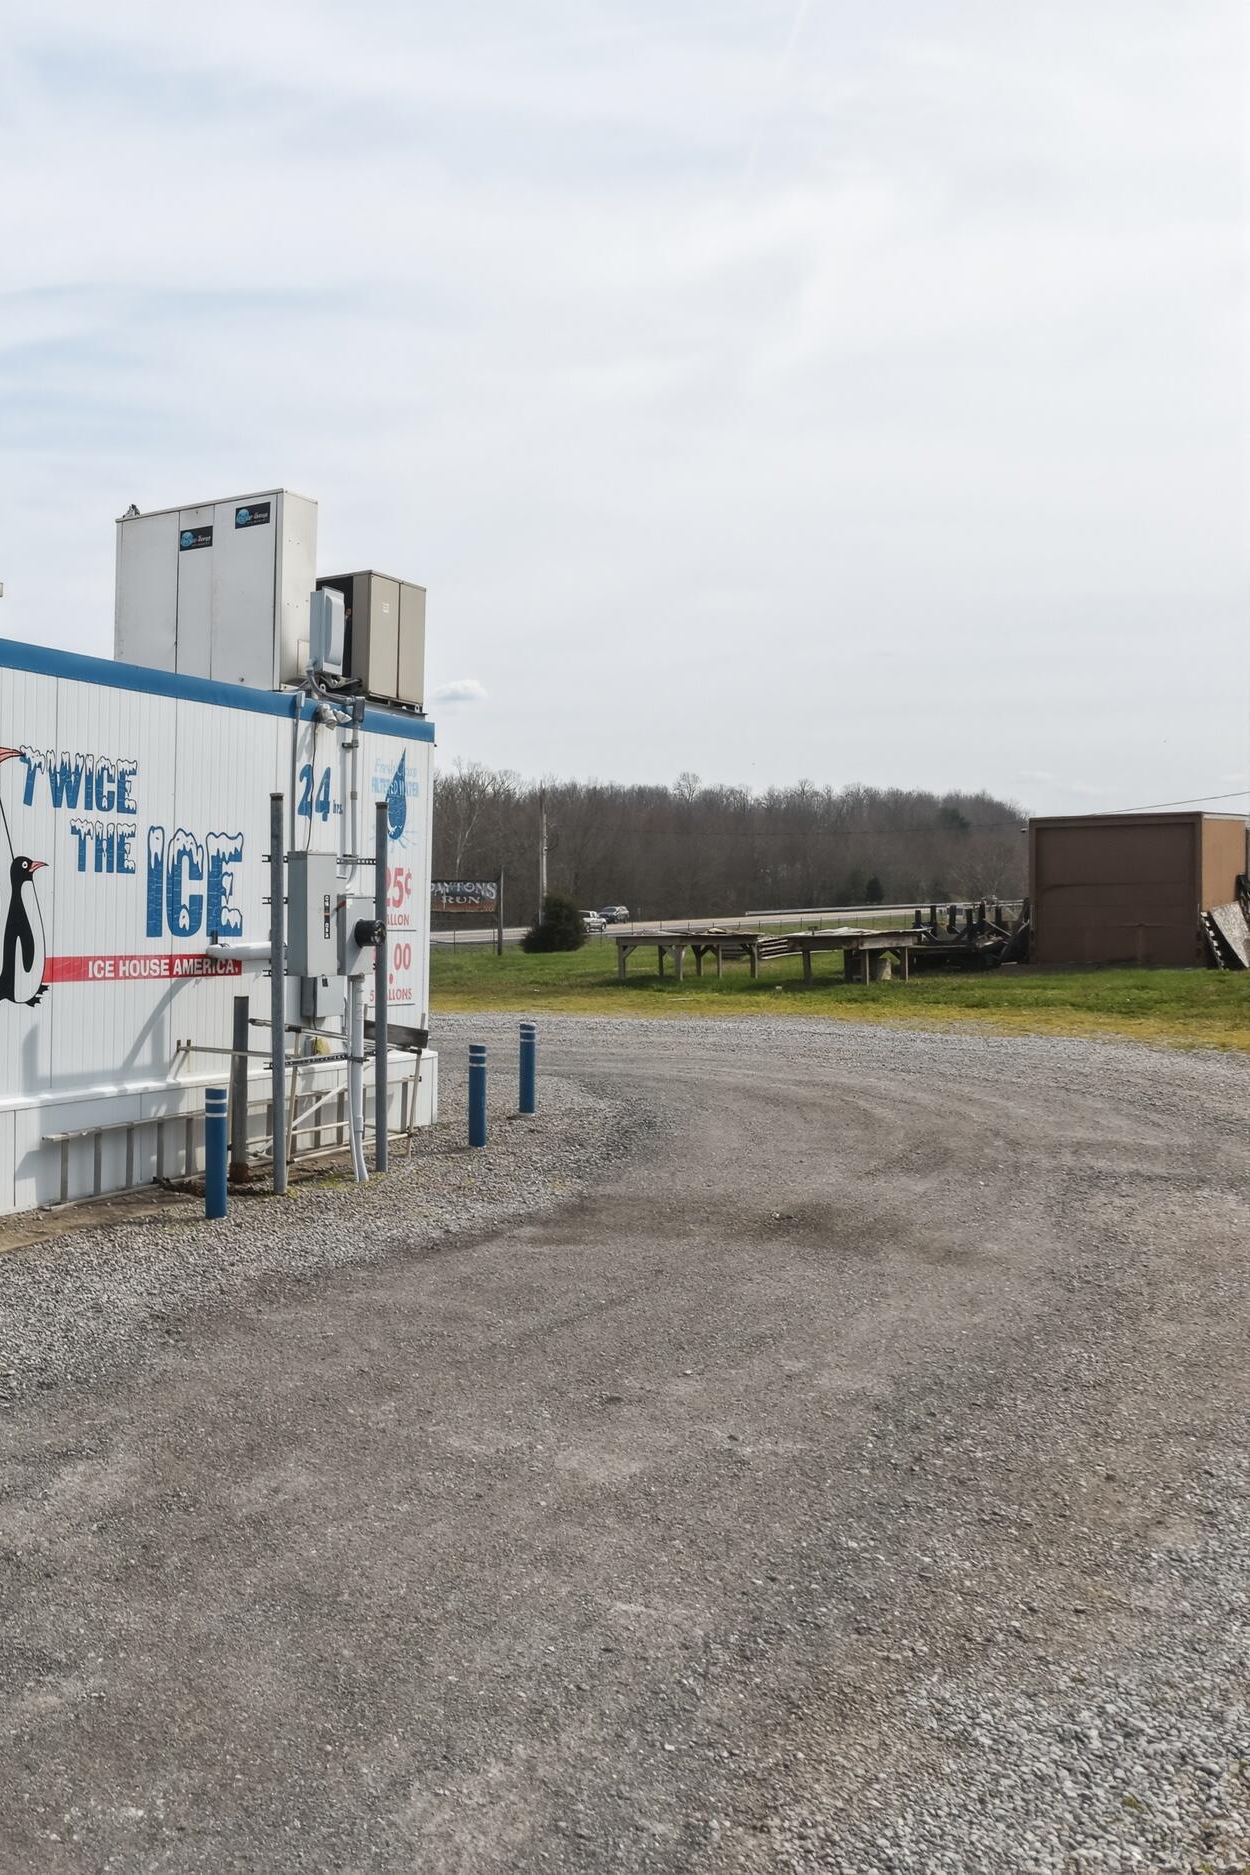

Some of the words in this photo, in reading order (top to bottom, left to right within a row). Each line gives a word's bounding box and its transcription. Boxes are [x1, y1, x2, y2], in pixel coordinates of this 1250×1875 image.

[19, 744, 137, 814] TWICE
[297, 763, 331, 822] 24
[70, 818, 137, 874] THE
[146, 826, 244, 938] ICE
[441, 896, 480, 904] RUN
[88, 960, 115, 978] ICE
[119, 958, 170, 978] HOUSE
